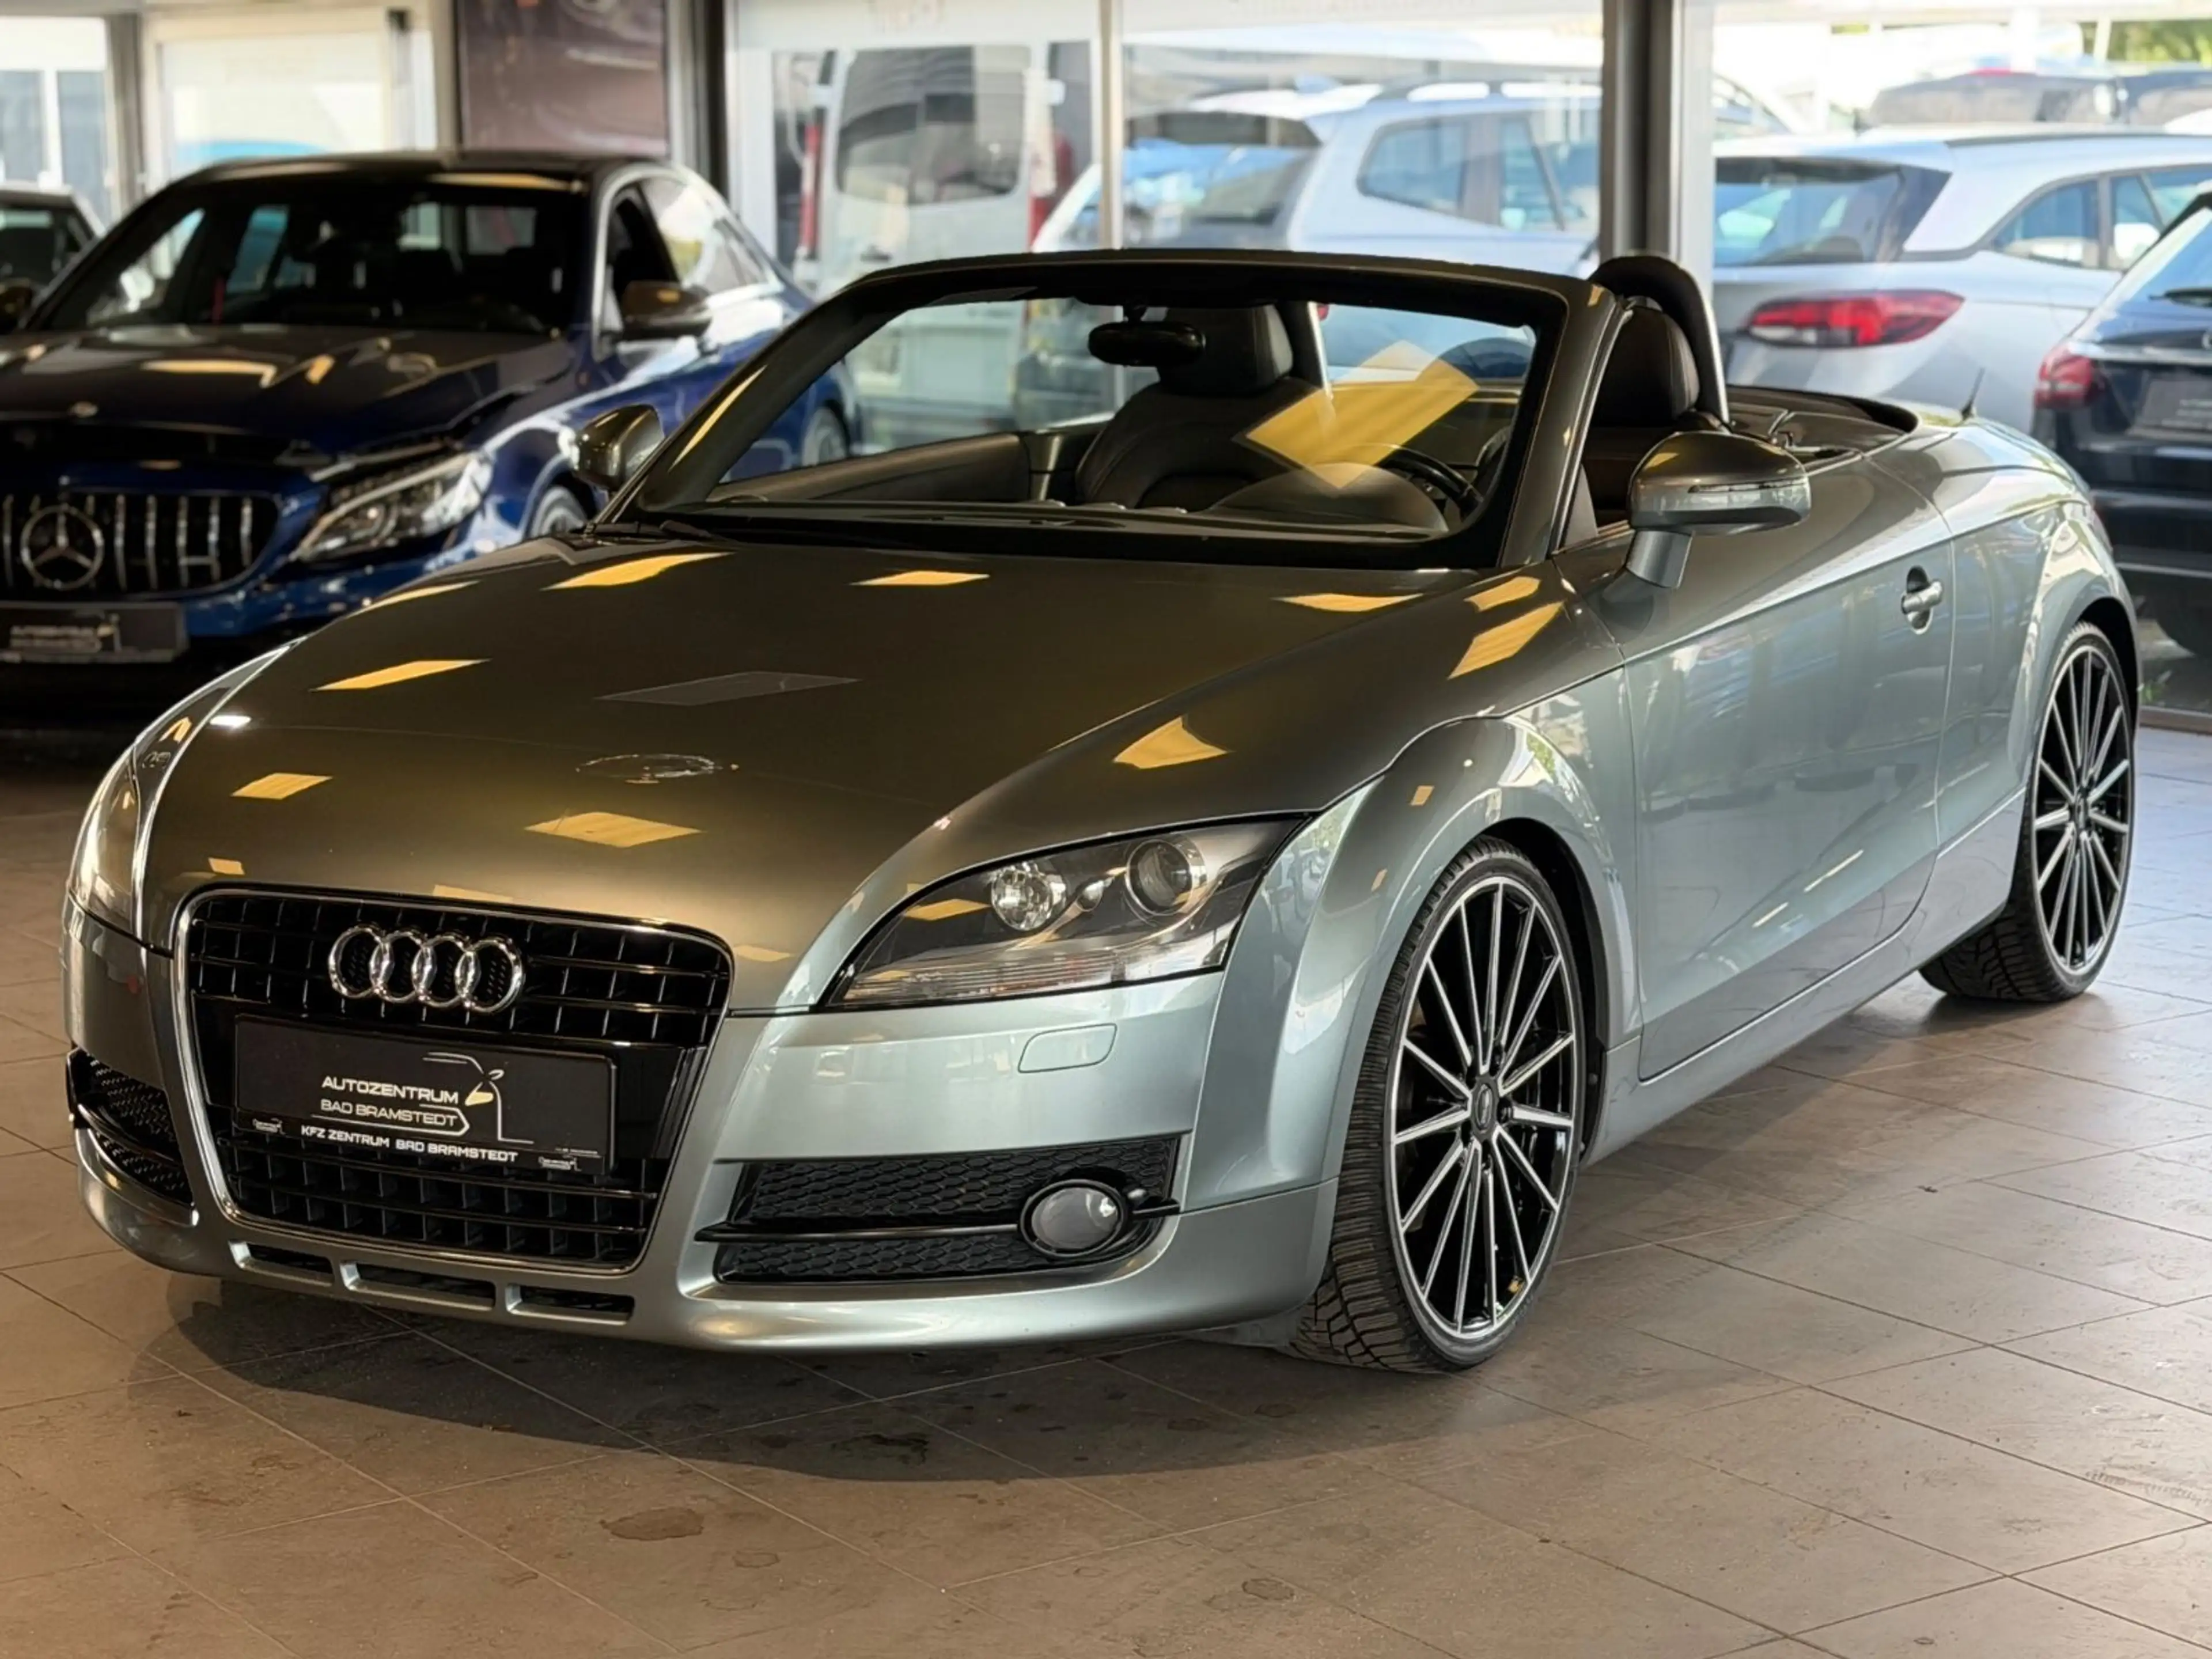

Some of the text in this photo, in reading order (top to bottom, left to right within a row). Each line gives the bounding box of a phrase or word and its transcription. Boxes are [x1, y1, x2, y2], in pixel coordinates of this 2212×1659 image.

[321, 1075, 459, 1105] AUTOZENTRUM
[320, 1099, 458, 1127] BAD BRAMSTEDT
[301, 1124, 518, 1162] KFZ ZENTRUM BAD BRAMSTEDT
